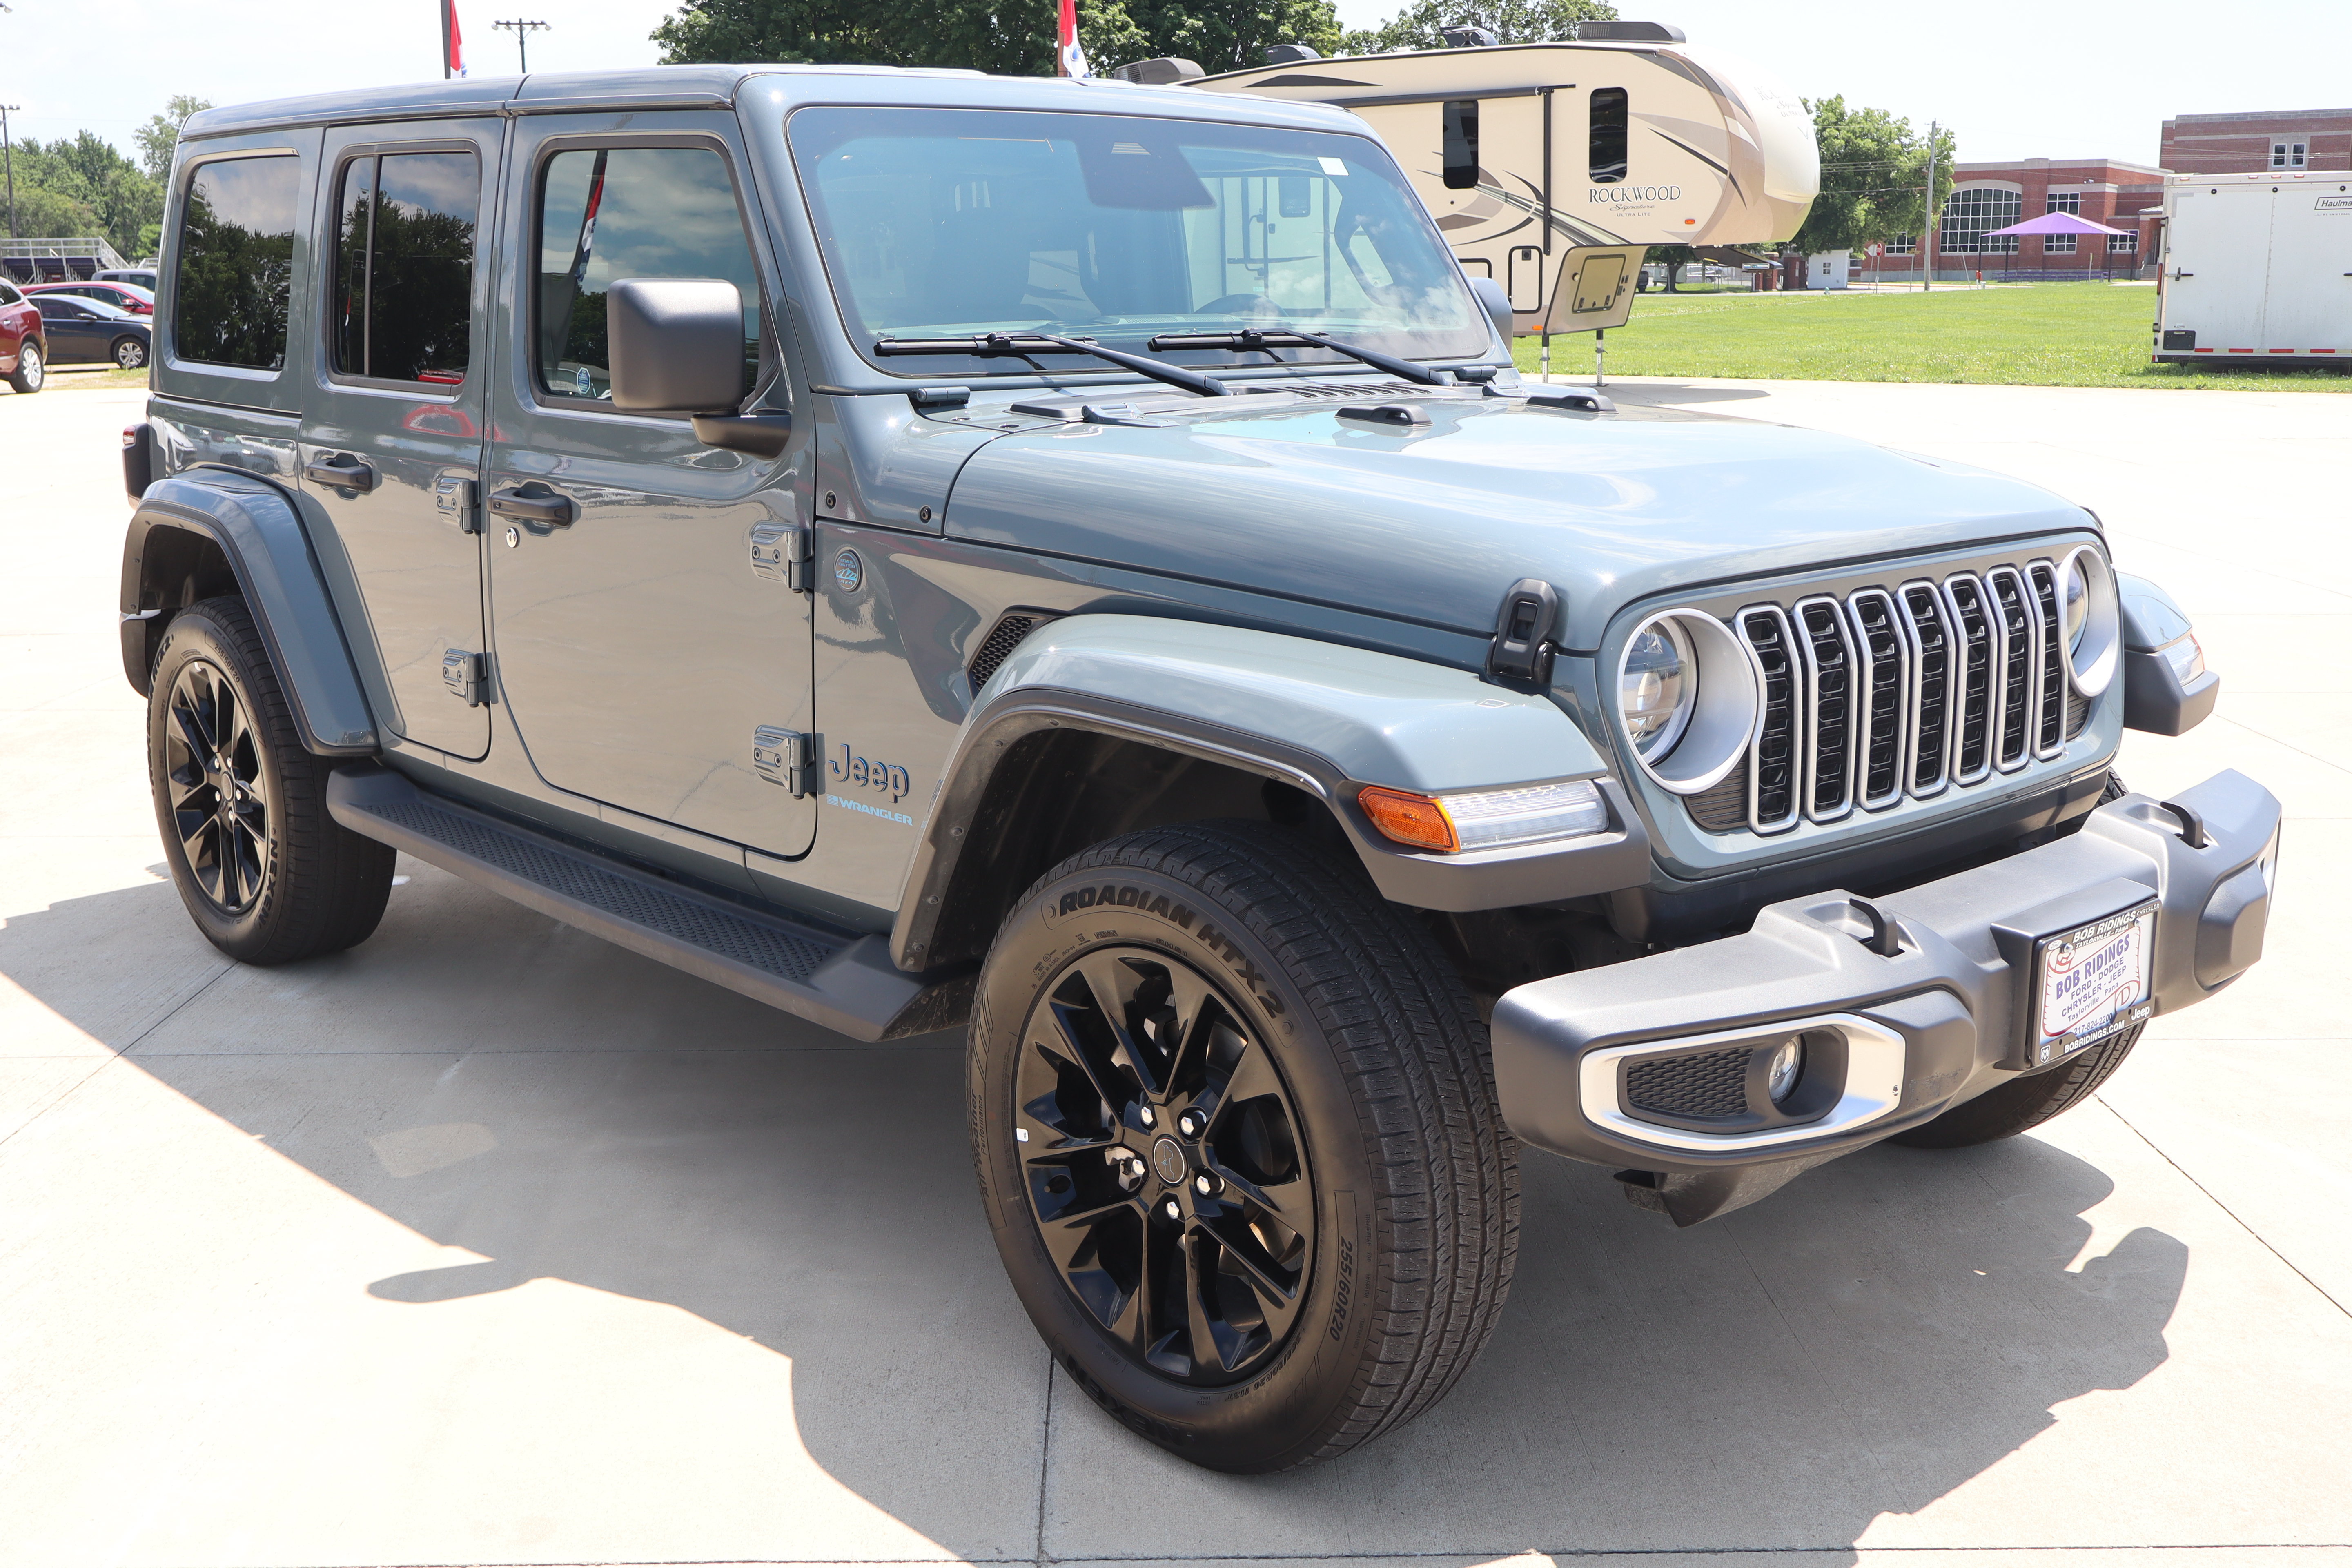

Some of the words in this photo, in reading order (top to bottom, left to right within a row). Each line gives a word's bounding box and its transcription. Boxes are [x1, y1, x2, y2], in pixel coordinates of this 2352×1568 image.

[1589, 186, 1681, 203] ROCKWOOD
[214, 644, 240, 683] 255/60R20
[828, 743, 910, 803] Jeep
[838, 797, 913, 826] WRANGLER
[255, 838, 278, 929] NEXEN
[2073, 926, 2095, 944] BOB
[2097, 911, 2136, 935] RIDINGS
[2136, 904, 2160, 916] CHRYSLER
[1060, 885, 1197, 930] ROADIAN
[1196, 923, 1285, 1019] HTX2
[2076, 932, 2111, 949] TAYLORVILLE
[2115, 924, 2129, 934] PANA
[2056, 969, 2080, 1000] BOB
[2085, 934, 2129, 980] RIDINGS
[2071, 980, 2091, 1000] FORD
[2099, 957, 2124, 980] DODGE
[2062, 984, 2102, 1017] CHRYSLER
[2108, 965, 2126, 986] JEEP
[2068, 996, 2099, 1022] Taylorville
[2105, 982, 2118, 996] Pana
[2074, 1012, 2113, 1036] 217-824-2200
[2131, 1006, 2150, 1020] Jeep
[2065, 1020, 2125, 1054] BOBRIDINGS.COM
[979, 1091, 987, 1155] Performance
[1329, 1236, 1353, 1341] 255/60R20
[1065, 1354, 1183, 1446] NEXEN
[1225, 1389, 1250, 1402] 113T
